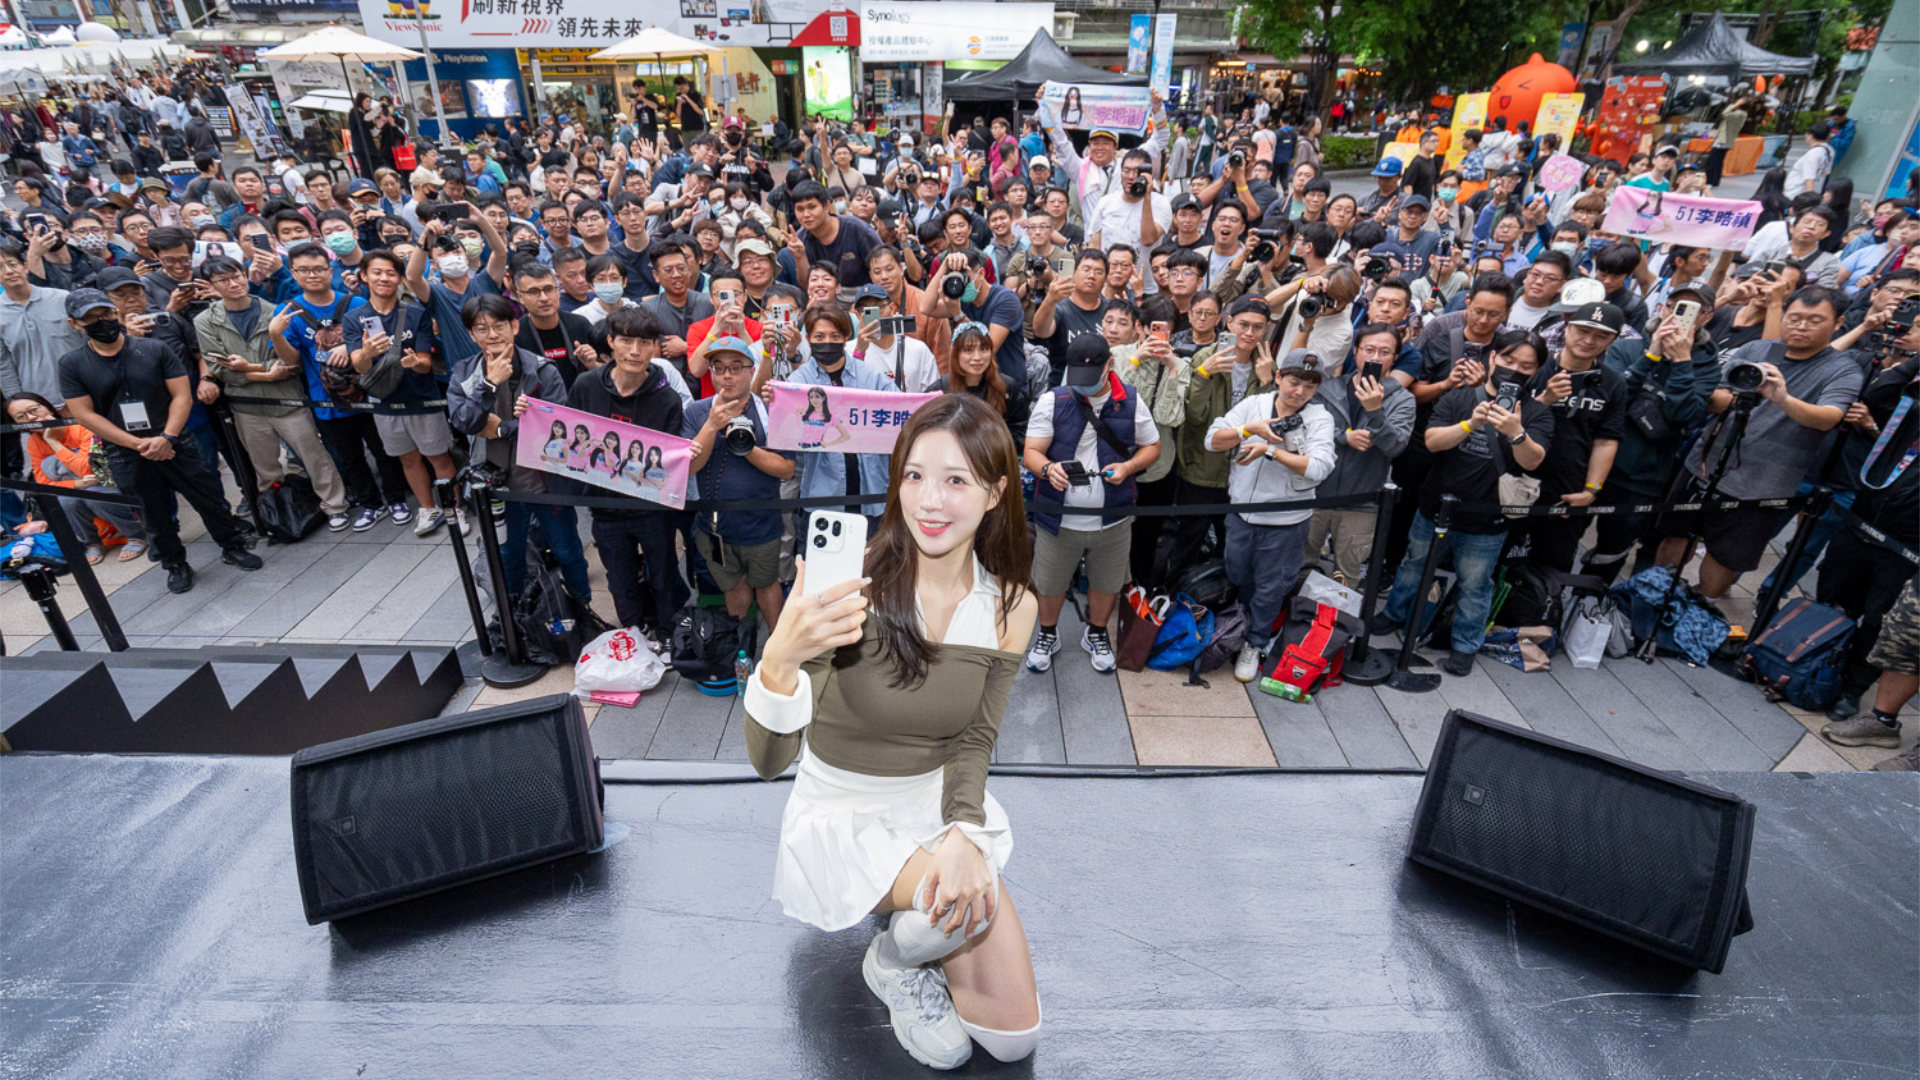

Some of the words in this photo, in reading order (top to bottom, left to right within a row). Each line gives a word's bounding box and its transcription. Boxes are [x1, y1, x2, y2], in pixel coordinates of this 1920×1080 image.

[472, 0, 564, 16] 刷新視界
[867, 8, 912, 24] Synology
[557, 17, 643, 38] 領先未來
[443, 54, 489, 64] PlayStation
